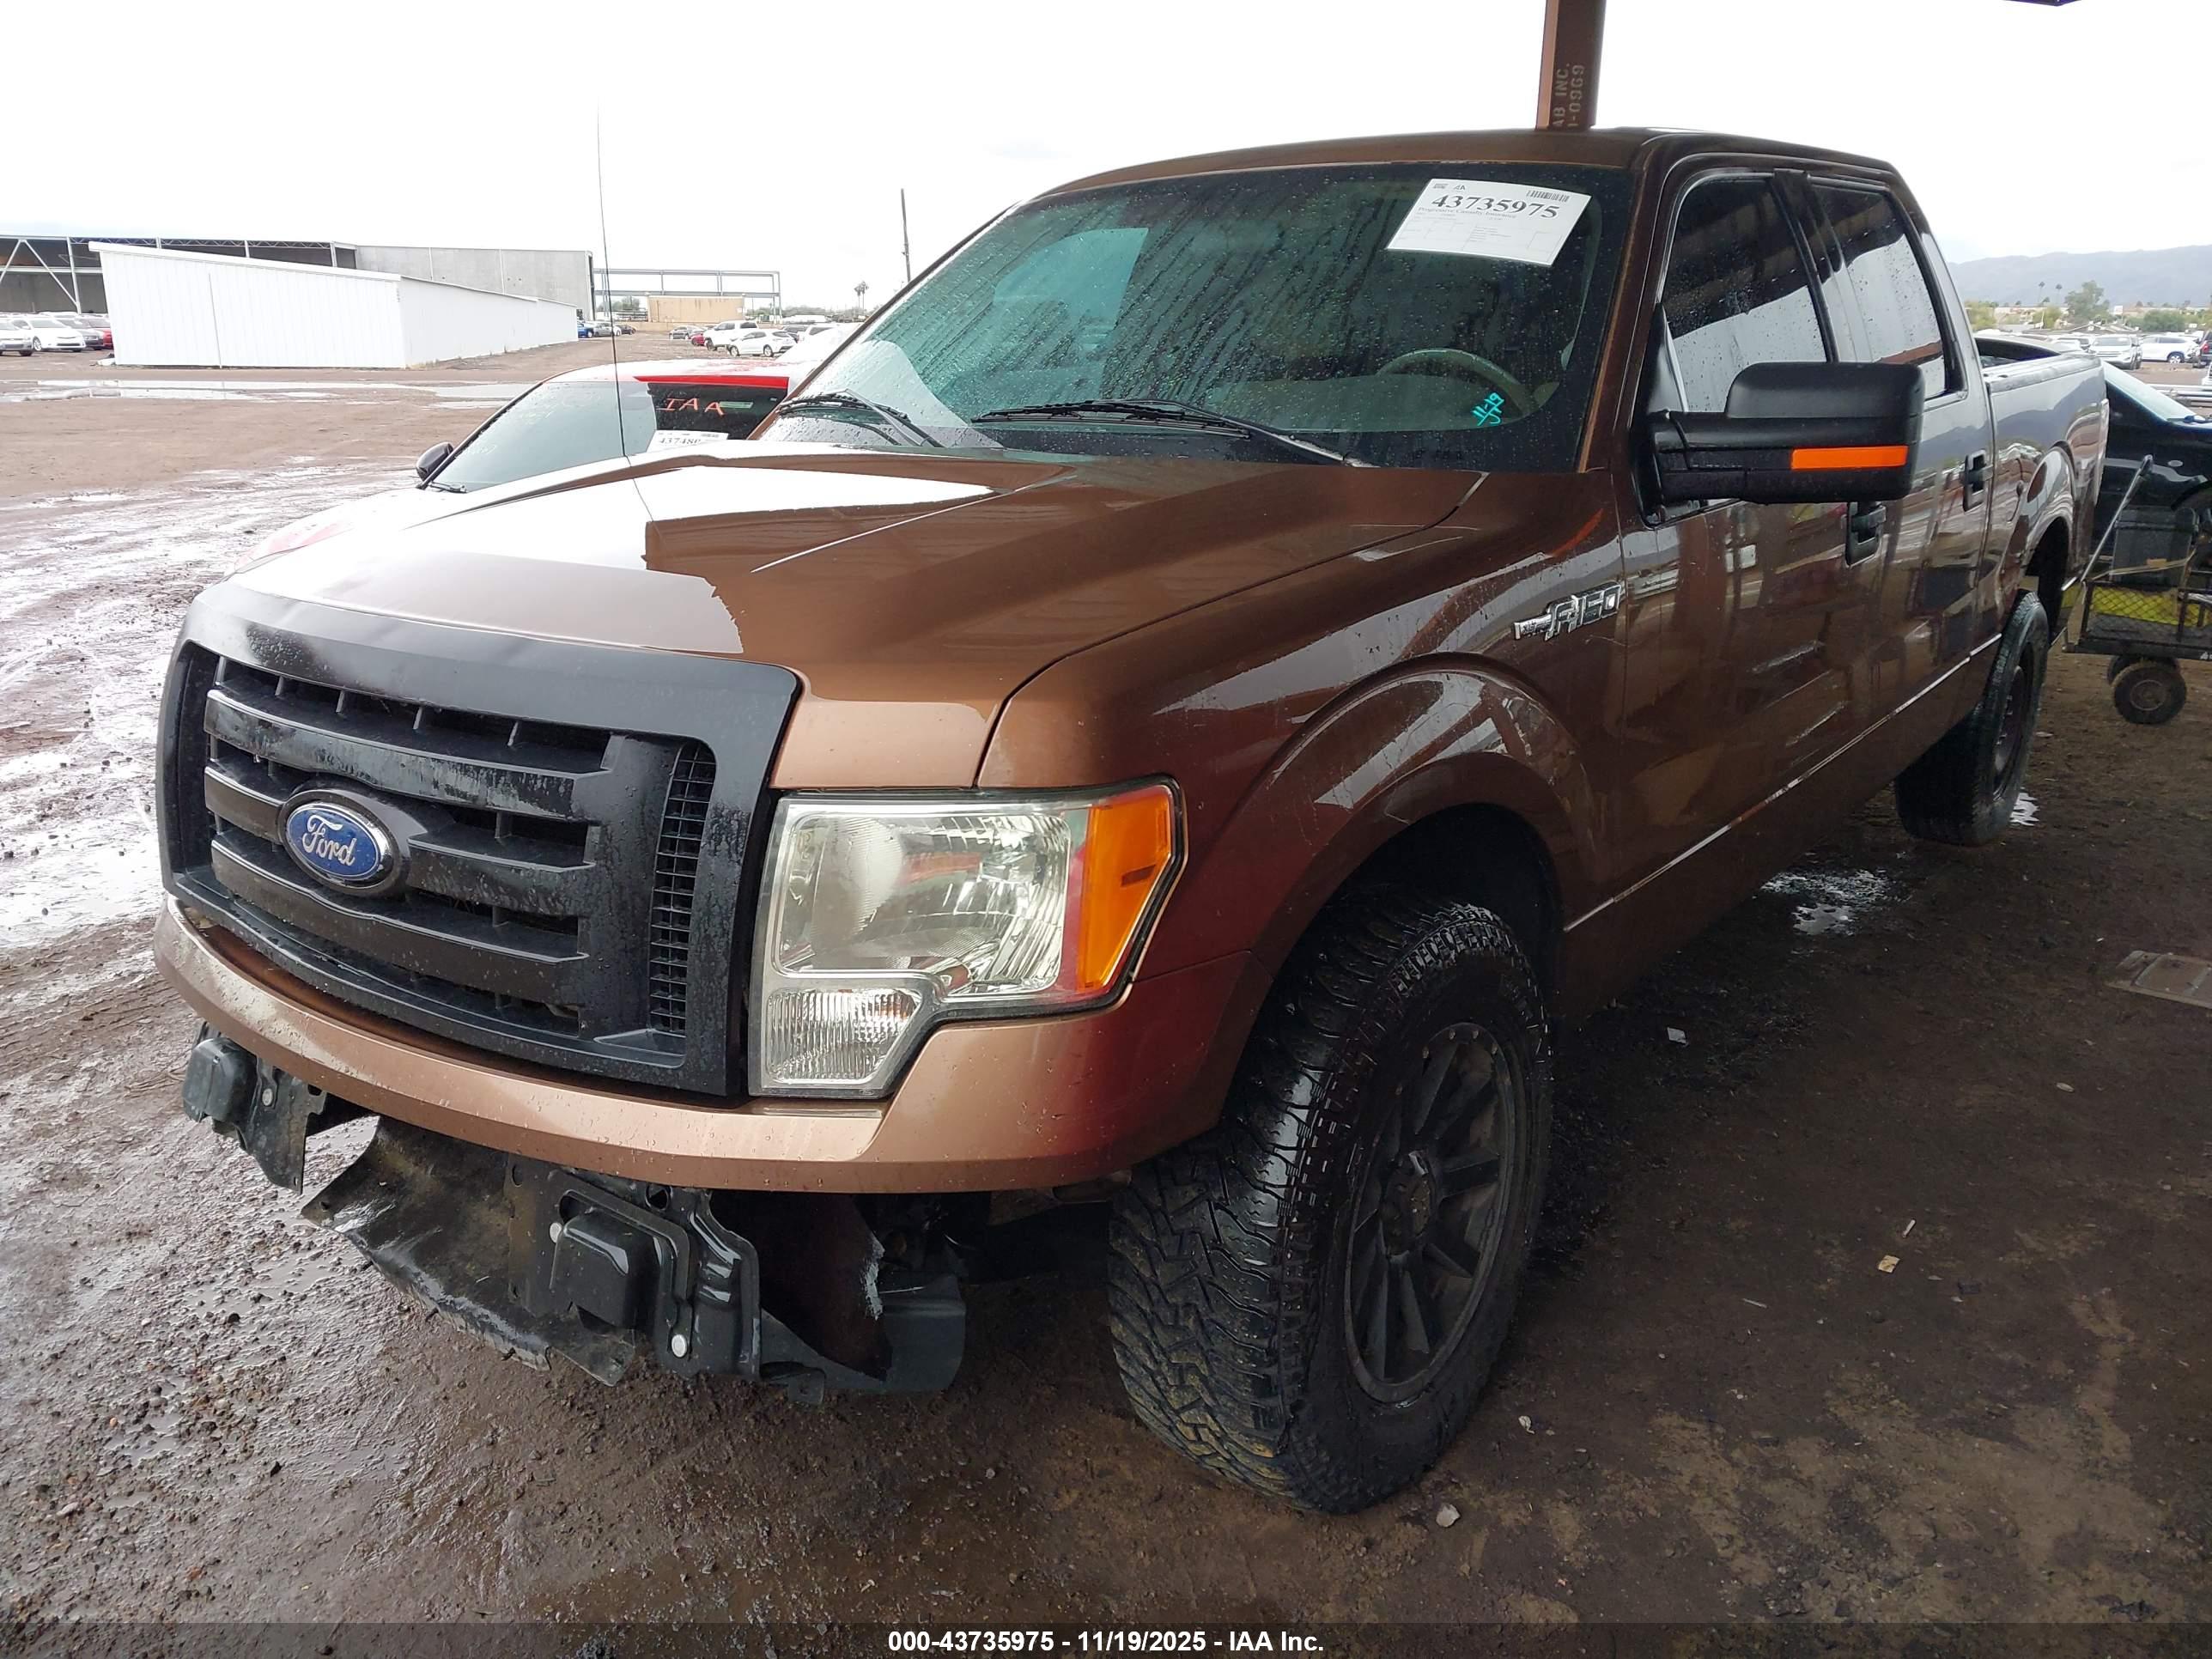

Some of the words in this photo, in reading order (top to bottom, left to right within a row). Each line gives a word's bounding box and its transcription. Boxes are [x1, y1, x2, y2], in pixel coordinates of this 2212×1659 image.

[1554, 64, 1570, 97] INC.
[1431, 194, 1560, 218] 43735975
[654, 398, 726, 416] IAA
[302, 814, 357, 866] Ford
